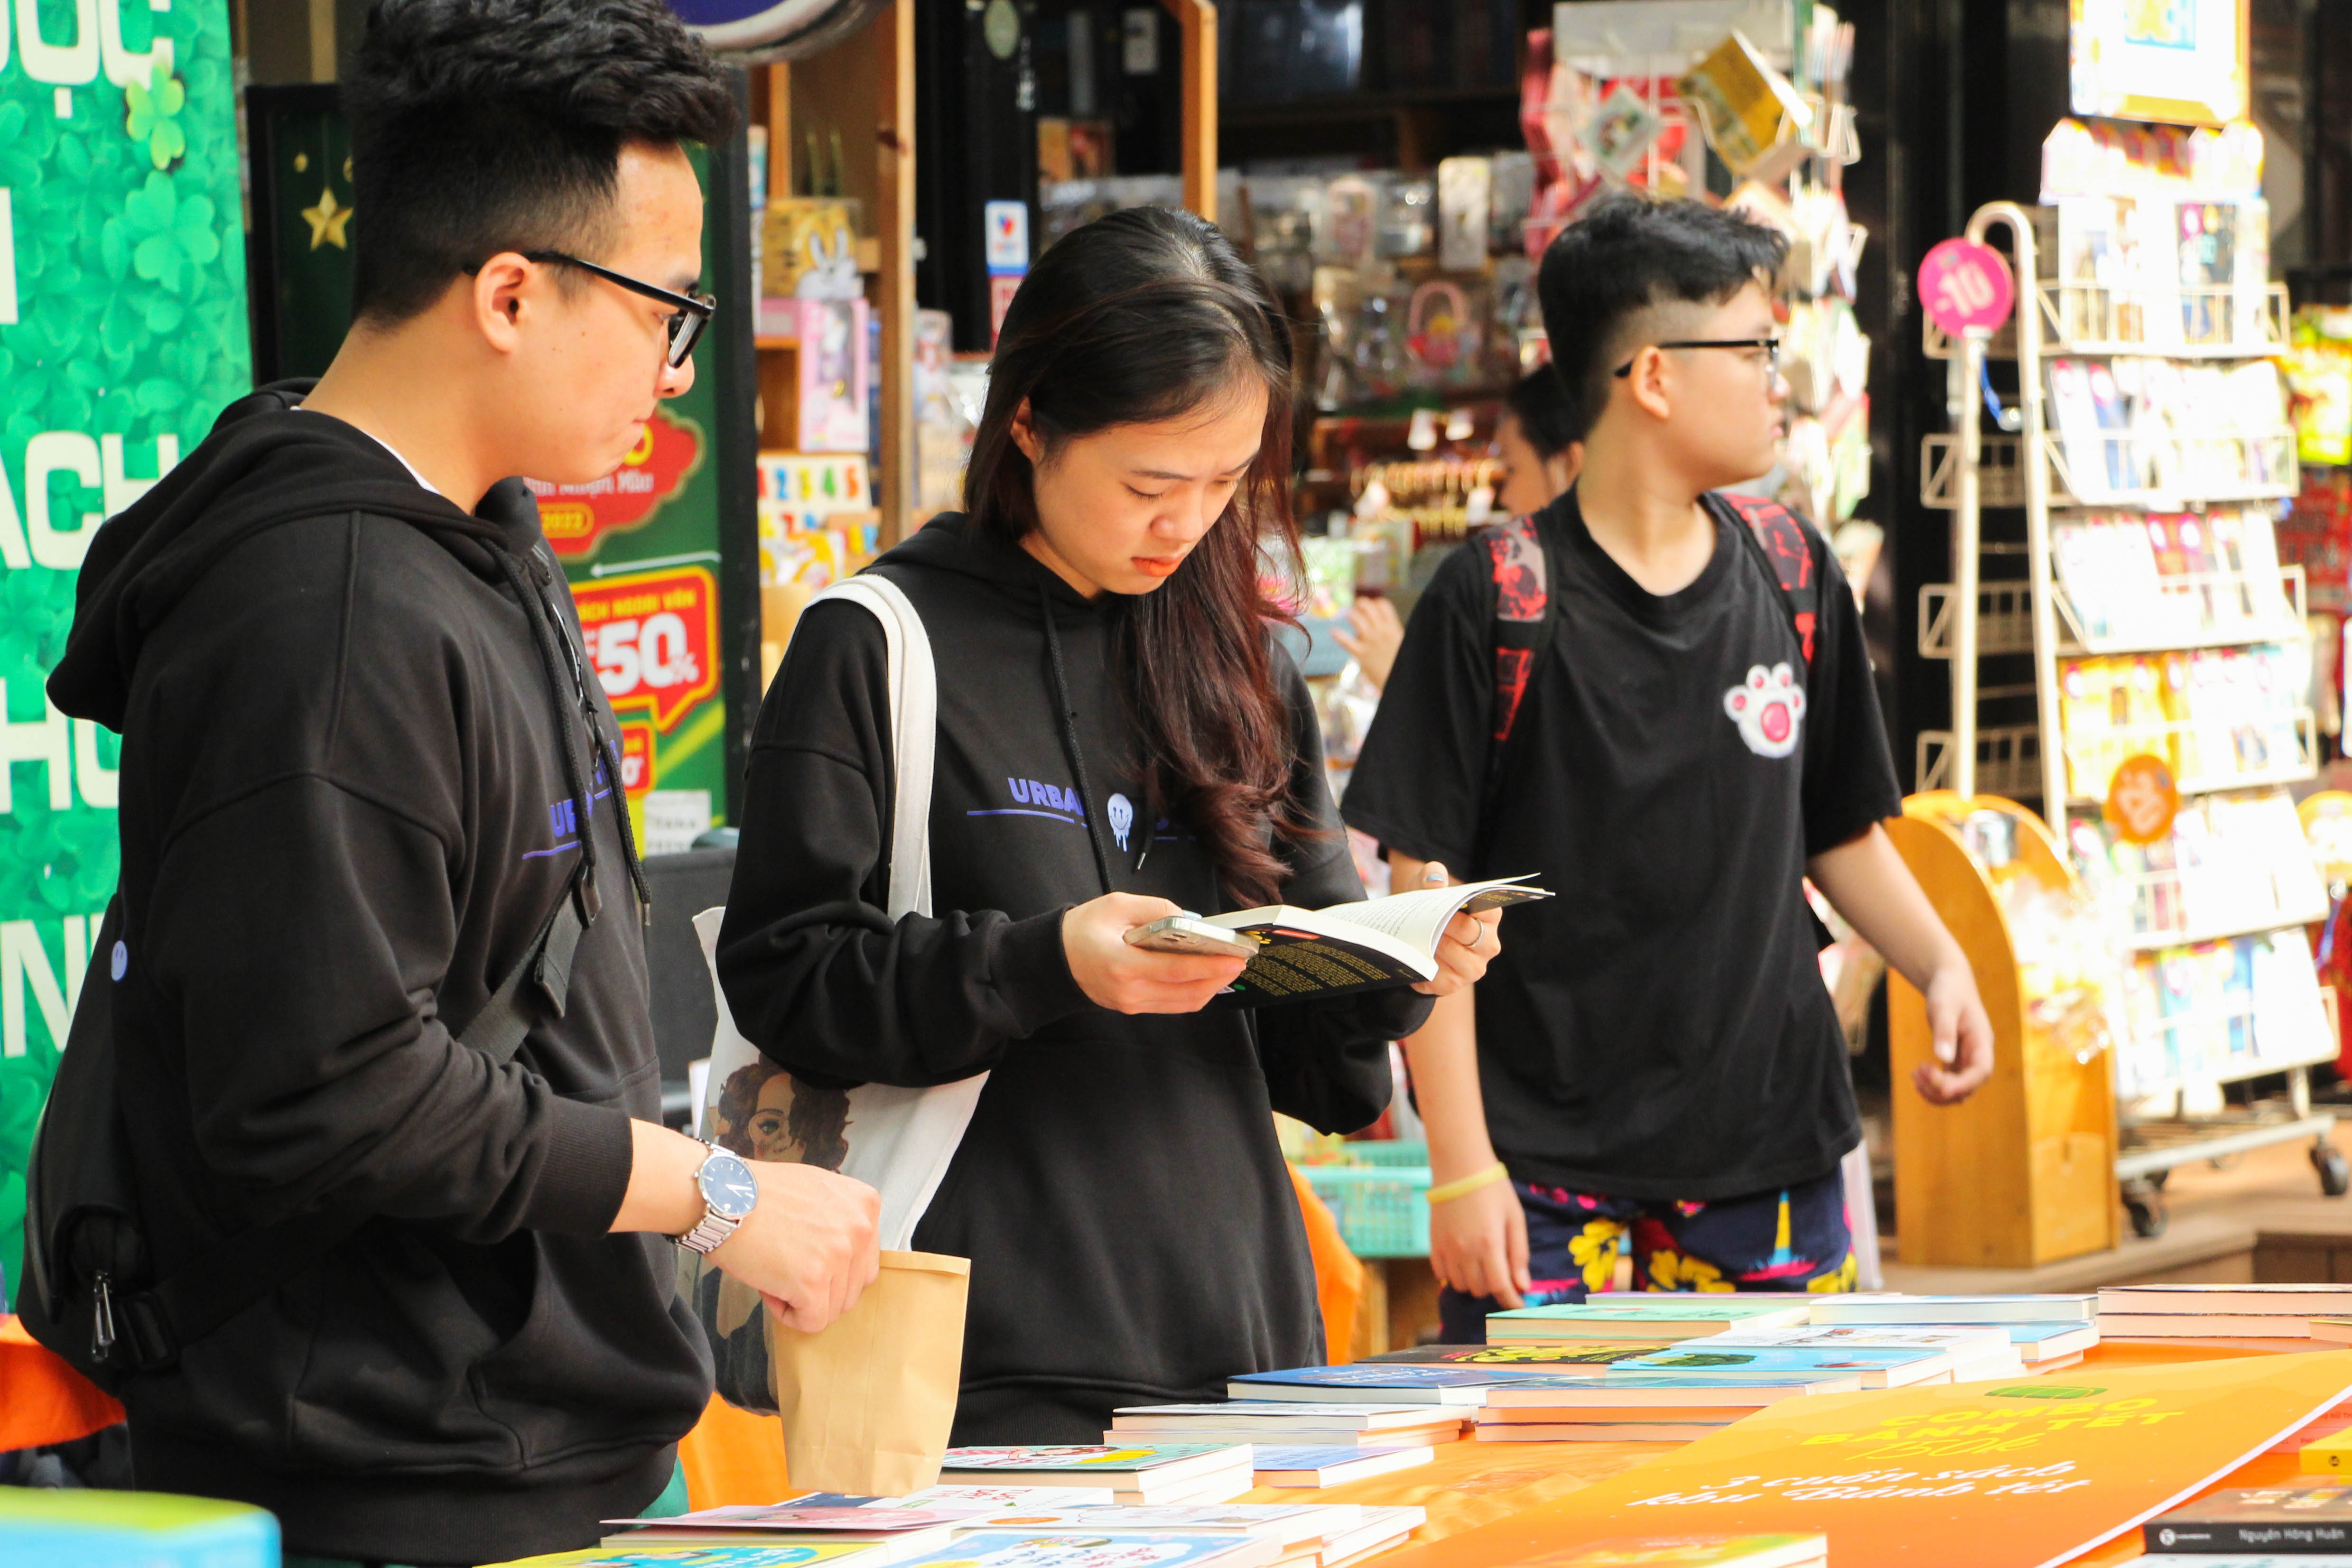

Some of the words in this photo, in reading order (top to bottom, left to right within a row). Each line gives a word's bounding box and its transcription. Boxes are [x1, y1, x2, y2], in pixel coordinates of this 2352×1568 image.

[1880, 1398, 2157, 1426] COMBO
[1799, 1422, 2020, 1446] BÁNH
[1700, 1475, 1761, 1489] 3
[1922, 1461, 2076, 1480] sách
